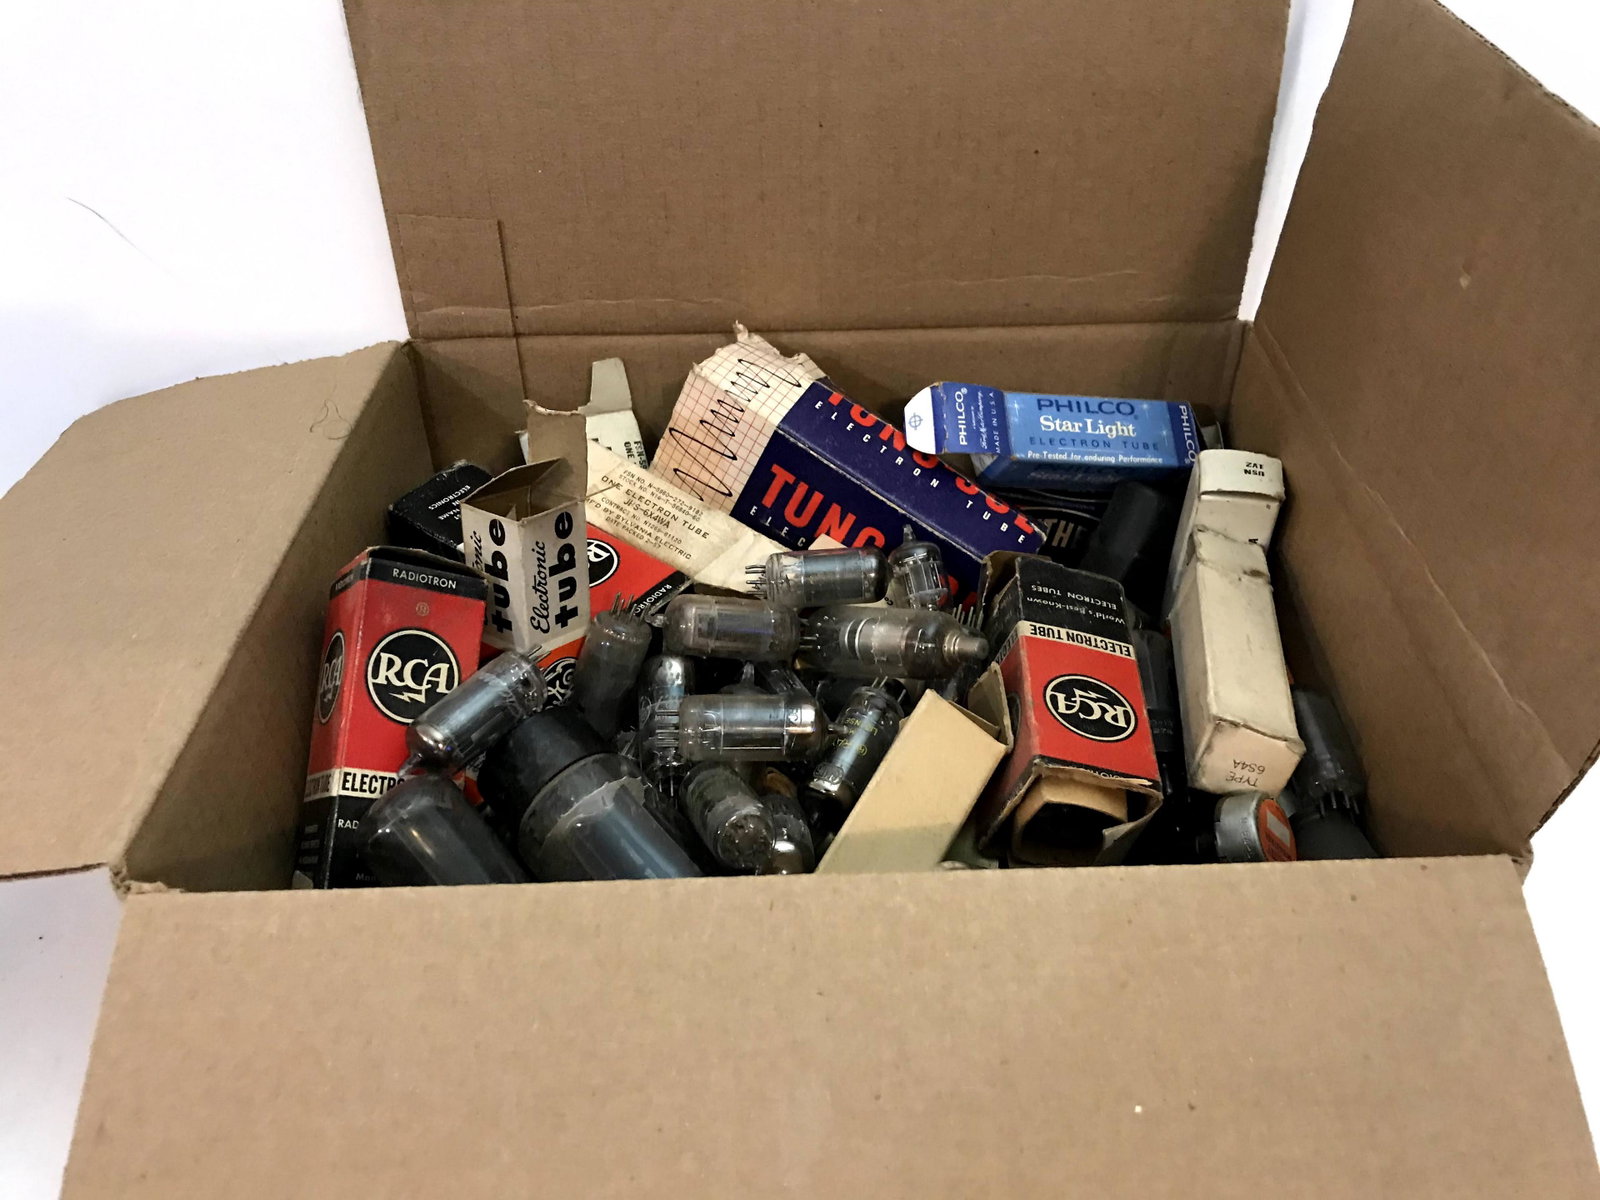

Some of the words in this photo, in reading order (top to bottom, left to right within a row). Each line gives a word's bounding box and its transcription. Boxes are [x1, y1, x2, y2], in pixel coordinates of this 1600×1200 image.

[955, 391, 967, 445] PHILCO
[1037, 398, 1135, 415] PHILCO
[991, 418, 998, 427] IN
[1040, 415, 1082, 432] Star
[1084, 418, 1136, 439] Light
[1178, 405, 1197, 462] PHILCO
[624, 441, 635, 459] ONE
[1029, 436, 1111, 448] ELECTRON
[1120, 440, 1159, 451] TUBE
[1070, 452, 1081, 461] for
[1084, 453, 1115, 464] enduring
[1118, 454, 1163, 464] Performance
[815, 400, 940, 488] ELECTRON
[966, 500, 1026, 544] TUBE
[1244, 469, 1265, 477] USN
[428, 485, 470, 510] ELECTRONICS
[601, 497, 631, 516] CONTRACT
[601, 475, 623, 491] ONE
[625, 489, 679, 522] ELECTRON
[681, 519, 710, 539] TUBE
[603, 507, 615, 517] BY
[615, 514, 653, 537] SYLVANIA
[653, 535, 692, 560] ELECTRIC
[605, 516, 621, 527] DATE
[622, 525, 645, 540] PACKED
[392, 568, 457, 590] RADIOTRON
[484, 518, 513, 633] tube
[549, 511, 579, 628] tube
[530, 540, 550, 634] Electronic
[634, 584, 672, 613] RADIOTRO
[1031, 584, 1061, 596] TUBES
[1026, 597, 1086, 614] Best-Known
[1067, 592, 1117, 610] ELECTRON
[1088, 610, 1125, 625] World's
[1029, 624, 1063, 640] TUBE
[1066, 631, 1132, 657] ELECTRON
[372, 652, 450, 695] RCA
[1051, 689, 1130, 728] RCA
[1225, 771, 1258, 787] TYPE
[1233, 759, 1265, 775] 6S4A
[341, 771, 405, 795] ELECTR
